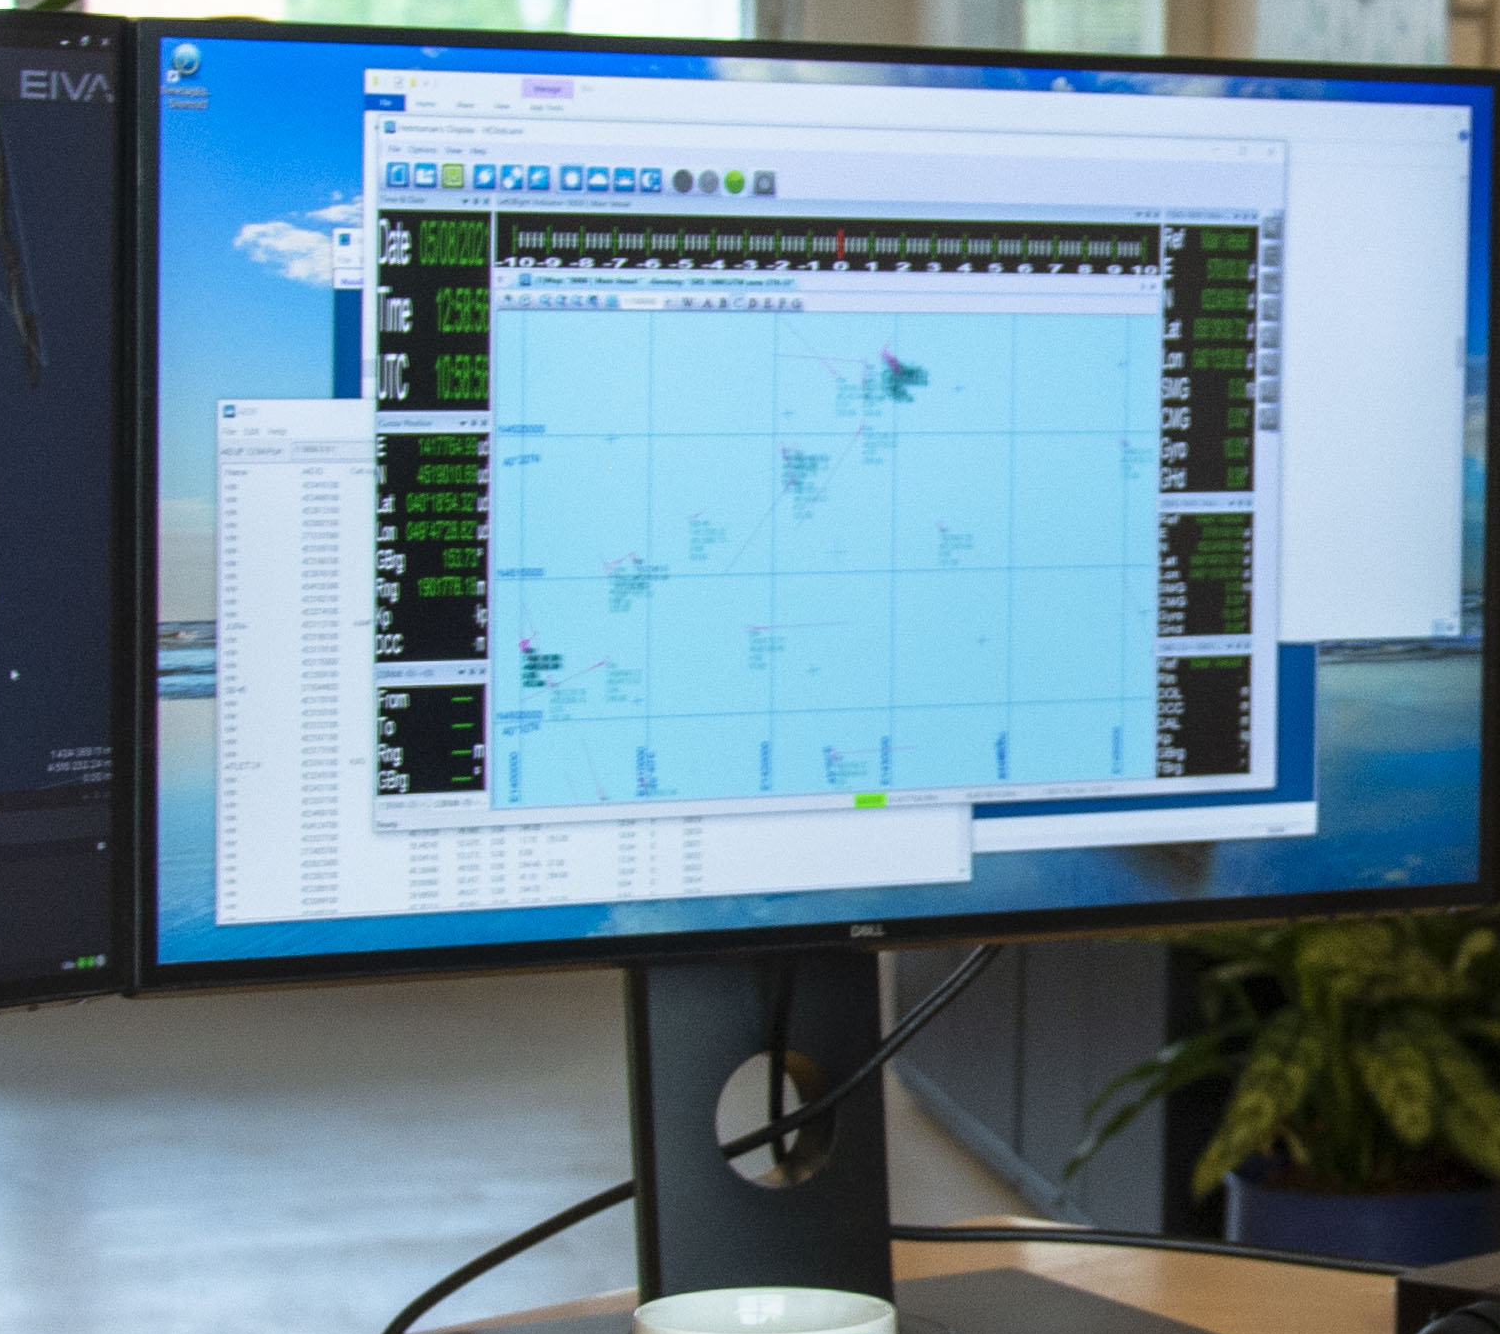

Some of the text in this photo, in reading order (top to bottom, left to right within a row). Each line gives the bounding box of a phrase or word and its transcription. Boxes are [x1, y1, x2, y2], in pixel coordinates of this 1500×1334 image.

[20, 70, 114, 103] EIVA
[379, 217, 412, 266] Date
[495, 257, 1158, 276] -10 -9 -8 -7 -6 -5 -4 -3 -2 -1 0 1 2 3 4 5 6 7 8 9 10
[377, 284, 414, 334] Time
[377, 351, 410, 402] UTC
[378, 689, 411, 710] From
[378, 717, 397, 737] To
[378, 744, 404, 768] Rng
